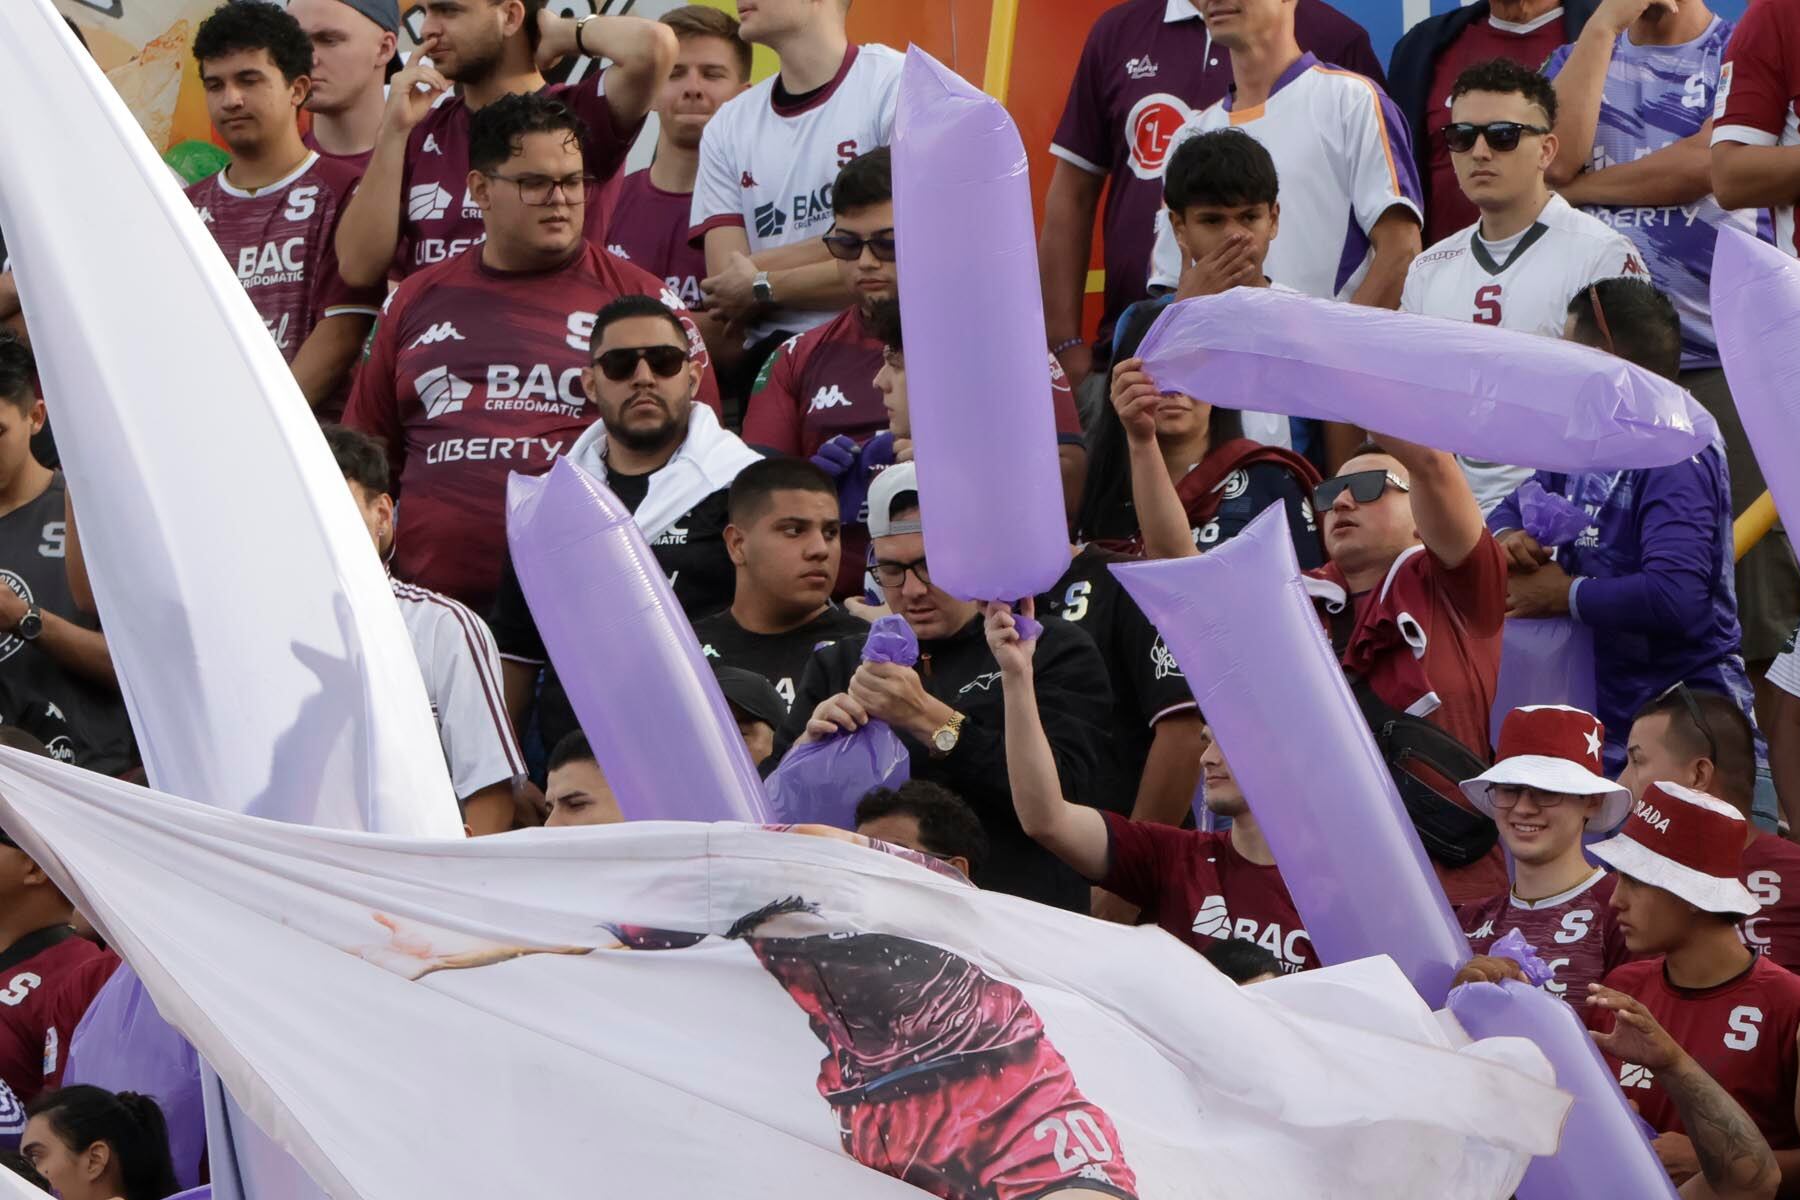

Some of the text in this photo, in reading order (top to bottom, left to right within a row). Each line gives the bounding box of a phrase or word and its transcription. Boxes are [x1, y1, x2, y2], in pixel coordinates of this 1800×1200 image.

[285, 186, 316, 222] S
[1600, 206, 1699, 228] BERTY
[238, 238, 304, 279] BAC
[241, 267, 304, 290] REDOMATIC
[1473, 285, 1499, 326] S
[566, 311, 601, 351] S
[486, 364, 587, 405] BAC
[485, 400, 582, 420] CREDOMATIC
[426, 438, 563, 465] LIBERTY
[39, 522, 66, 557] S
[1063, 583, 1090, 621] S
[1747, 870, 1780, 905] S
[1555, 910, 1594, 944] S
[0, 973, 41, 1006] S
[1723, 1005, 1763, 1052] S
[1034, 1110, 1113, 1173] 20
